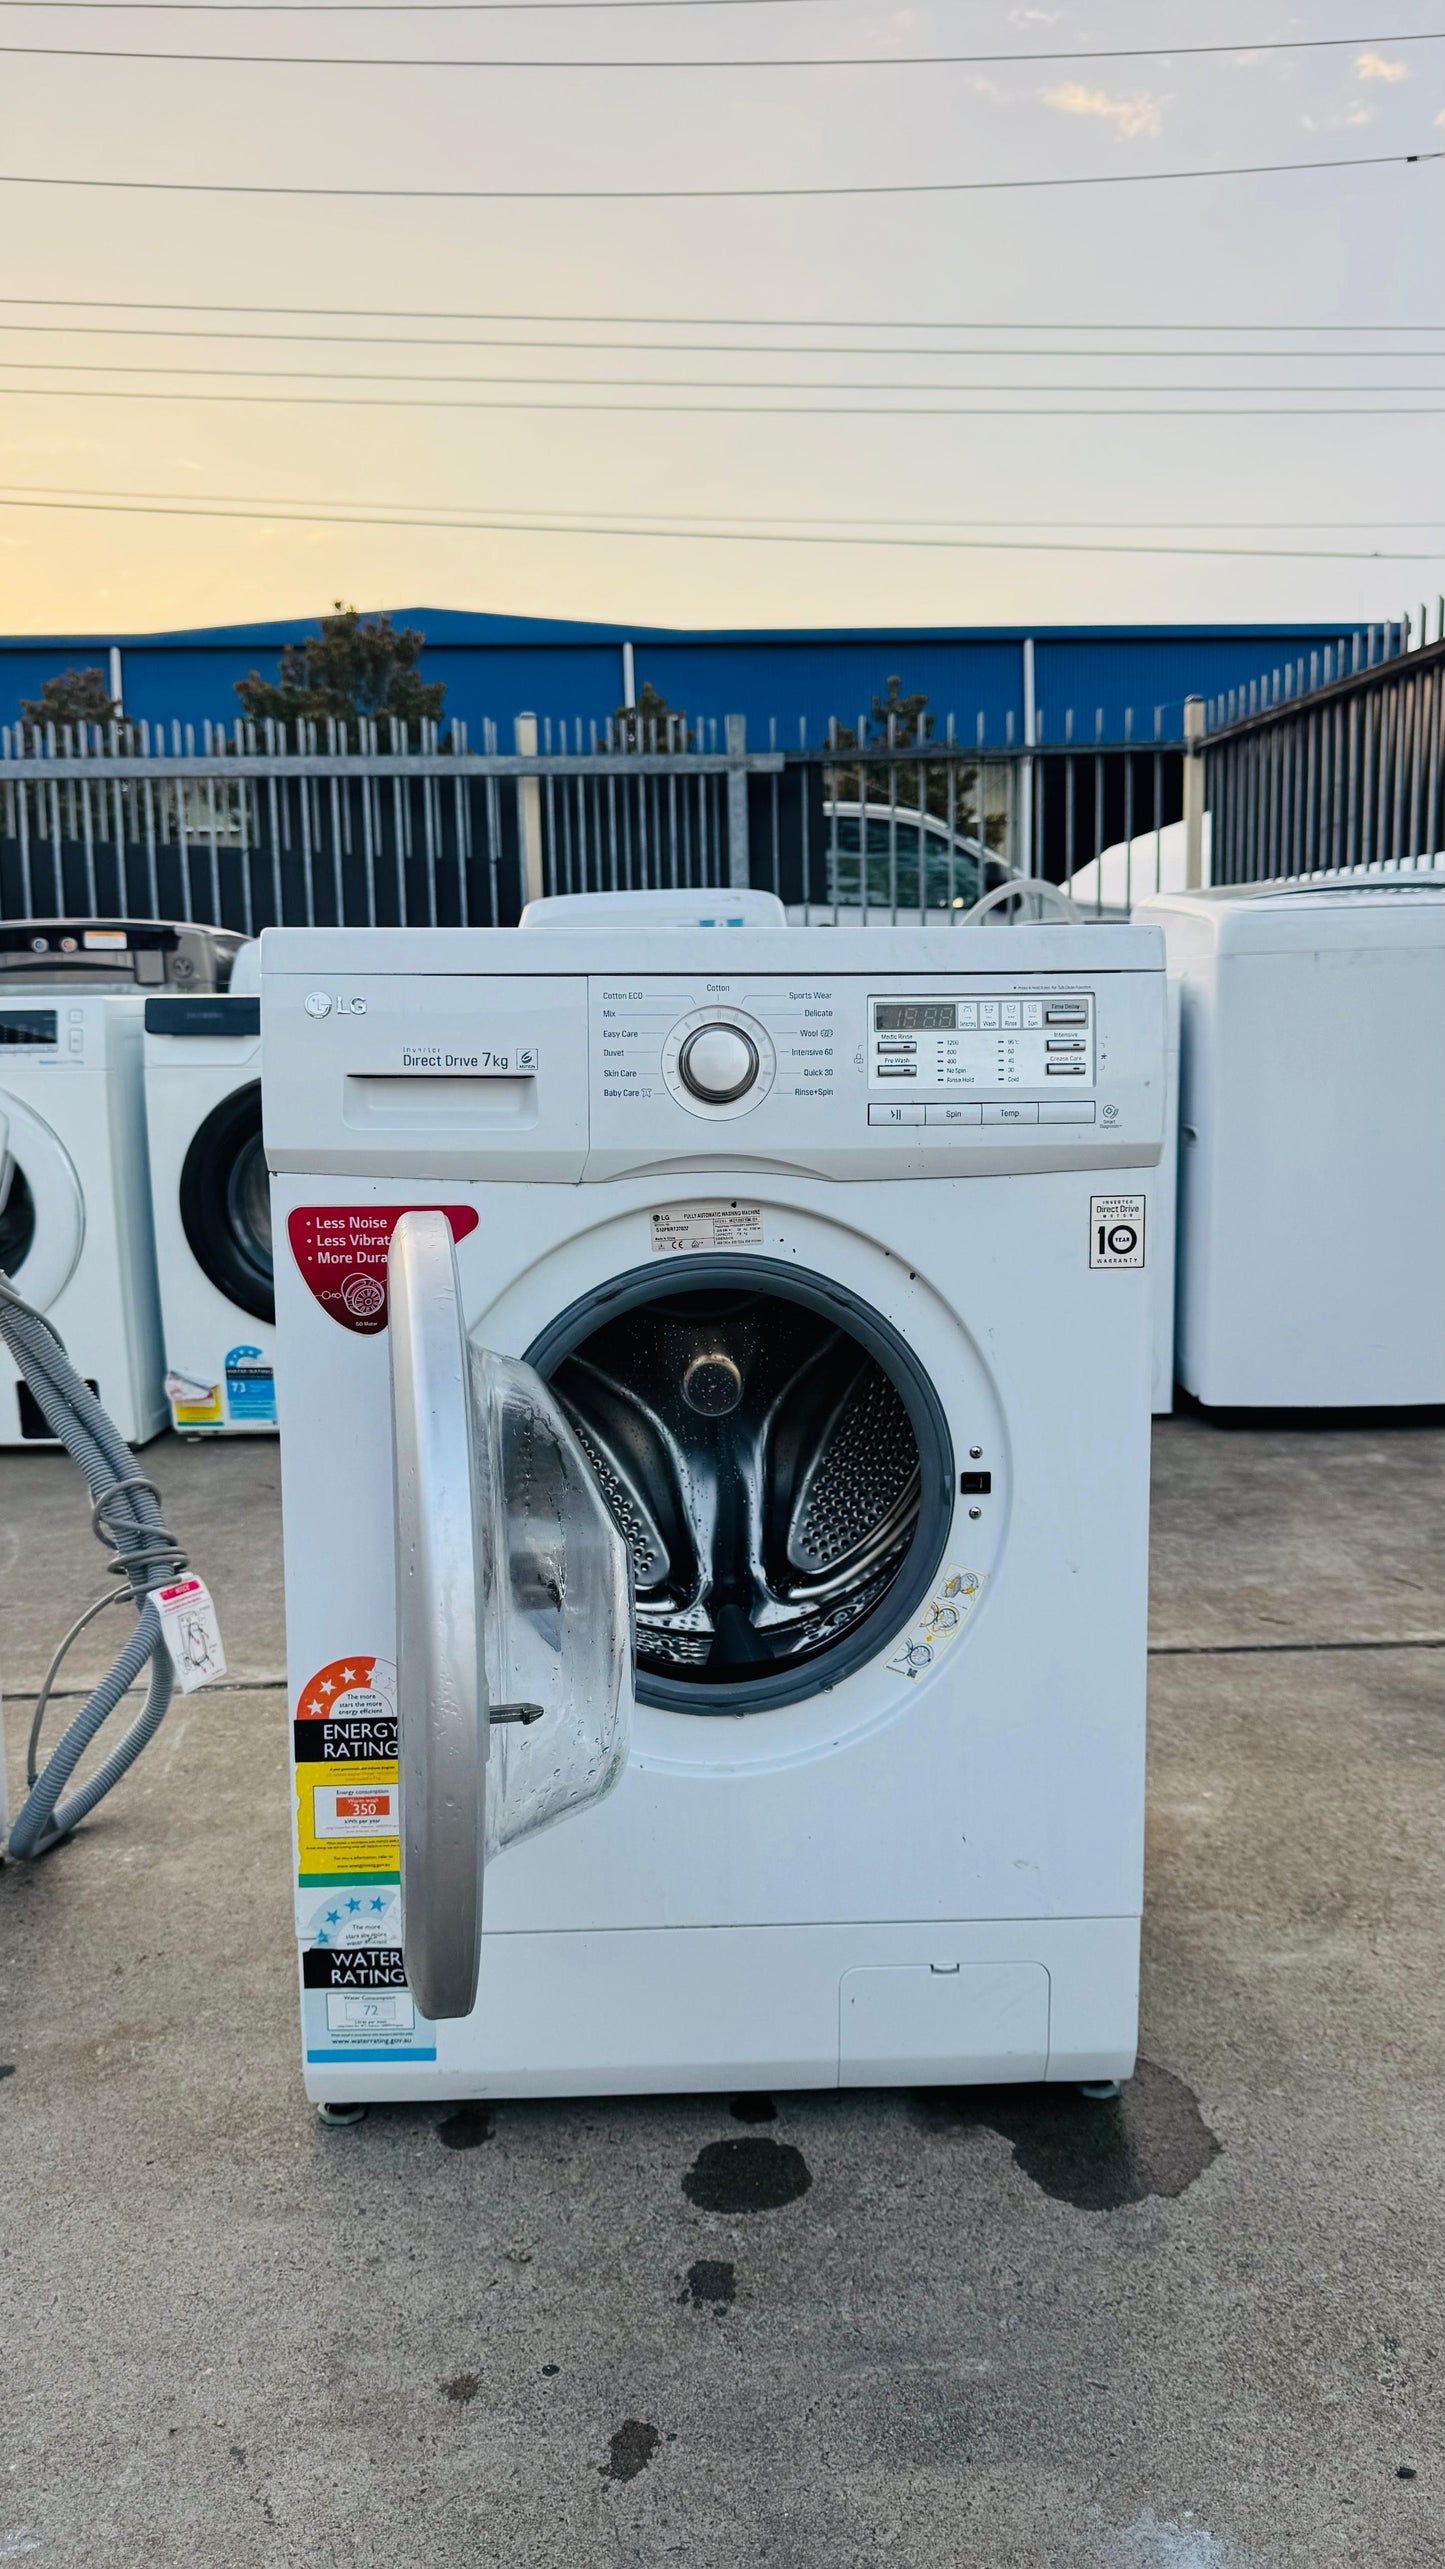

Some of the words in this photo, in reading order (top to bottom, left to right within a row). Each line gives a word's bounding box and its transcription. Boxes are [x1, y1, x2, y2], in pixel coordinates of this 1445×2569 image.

[706, 984, 730, 992] Cotton
[603, 992, 627, 1000] Cotton
[628, 992, 643, 1000] ECO
[788, 991, 812, 1000] Sports
[813, 991, 832, 999] Wear
[336, 995, 367, 1015] LG
[603, 1010, 616, 1018] Mix
[804, 1009, 833, 1017] Delicate
[603, 1030, 620, 1039] Easy
[621, 1030, 638, 1038] Care
[800, 1029, 818, 1037] Wool
[603, 1049, 624, 1057] Duvet
[791, 1048, 823, 1056] Intensive
[824, 1048, 833, 1056] 60
[402, 1054, 442, 1067] Direct
[445, 1054, 478, 1067] Drive
[603, 1069, 620, 1077] Skin
[621, 1069, 637, 1077] Care
[803, 1068, 823, 1077] Quick
[824, 1068, 833, 1076] 30
[603, 1089, 622, 1098] Baby
[622, 1089, 640, 1097] Care
[794, 1088, 833, 1097] Rinse+Spin
[945, 1110, 962, 1118] Spin
[1096, 1205, 1119, 1213] Direct
[1120, 1205, 1140, 1213] Drive
[316, 1217, 345, 1229] Less
[349, 1216, 388, 1229] Noise
[316, 1235, 346, 1247] Less
[1097, 1225, 1138, 1254] 10
[317, 1252, 353, 1264] More
[323, 1722, 398, 1740] ENERGY
[324, 1740, 398, 1758] RATING
[353, 1803, 377, 1815] 350
[331, 1951, 402, 1968] WATER
[330, 1968, 405, 1985] RATING
[364, 2004, 379, 2016] 72
